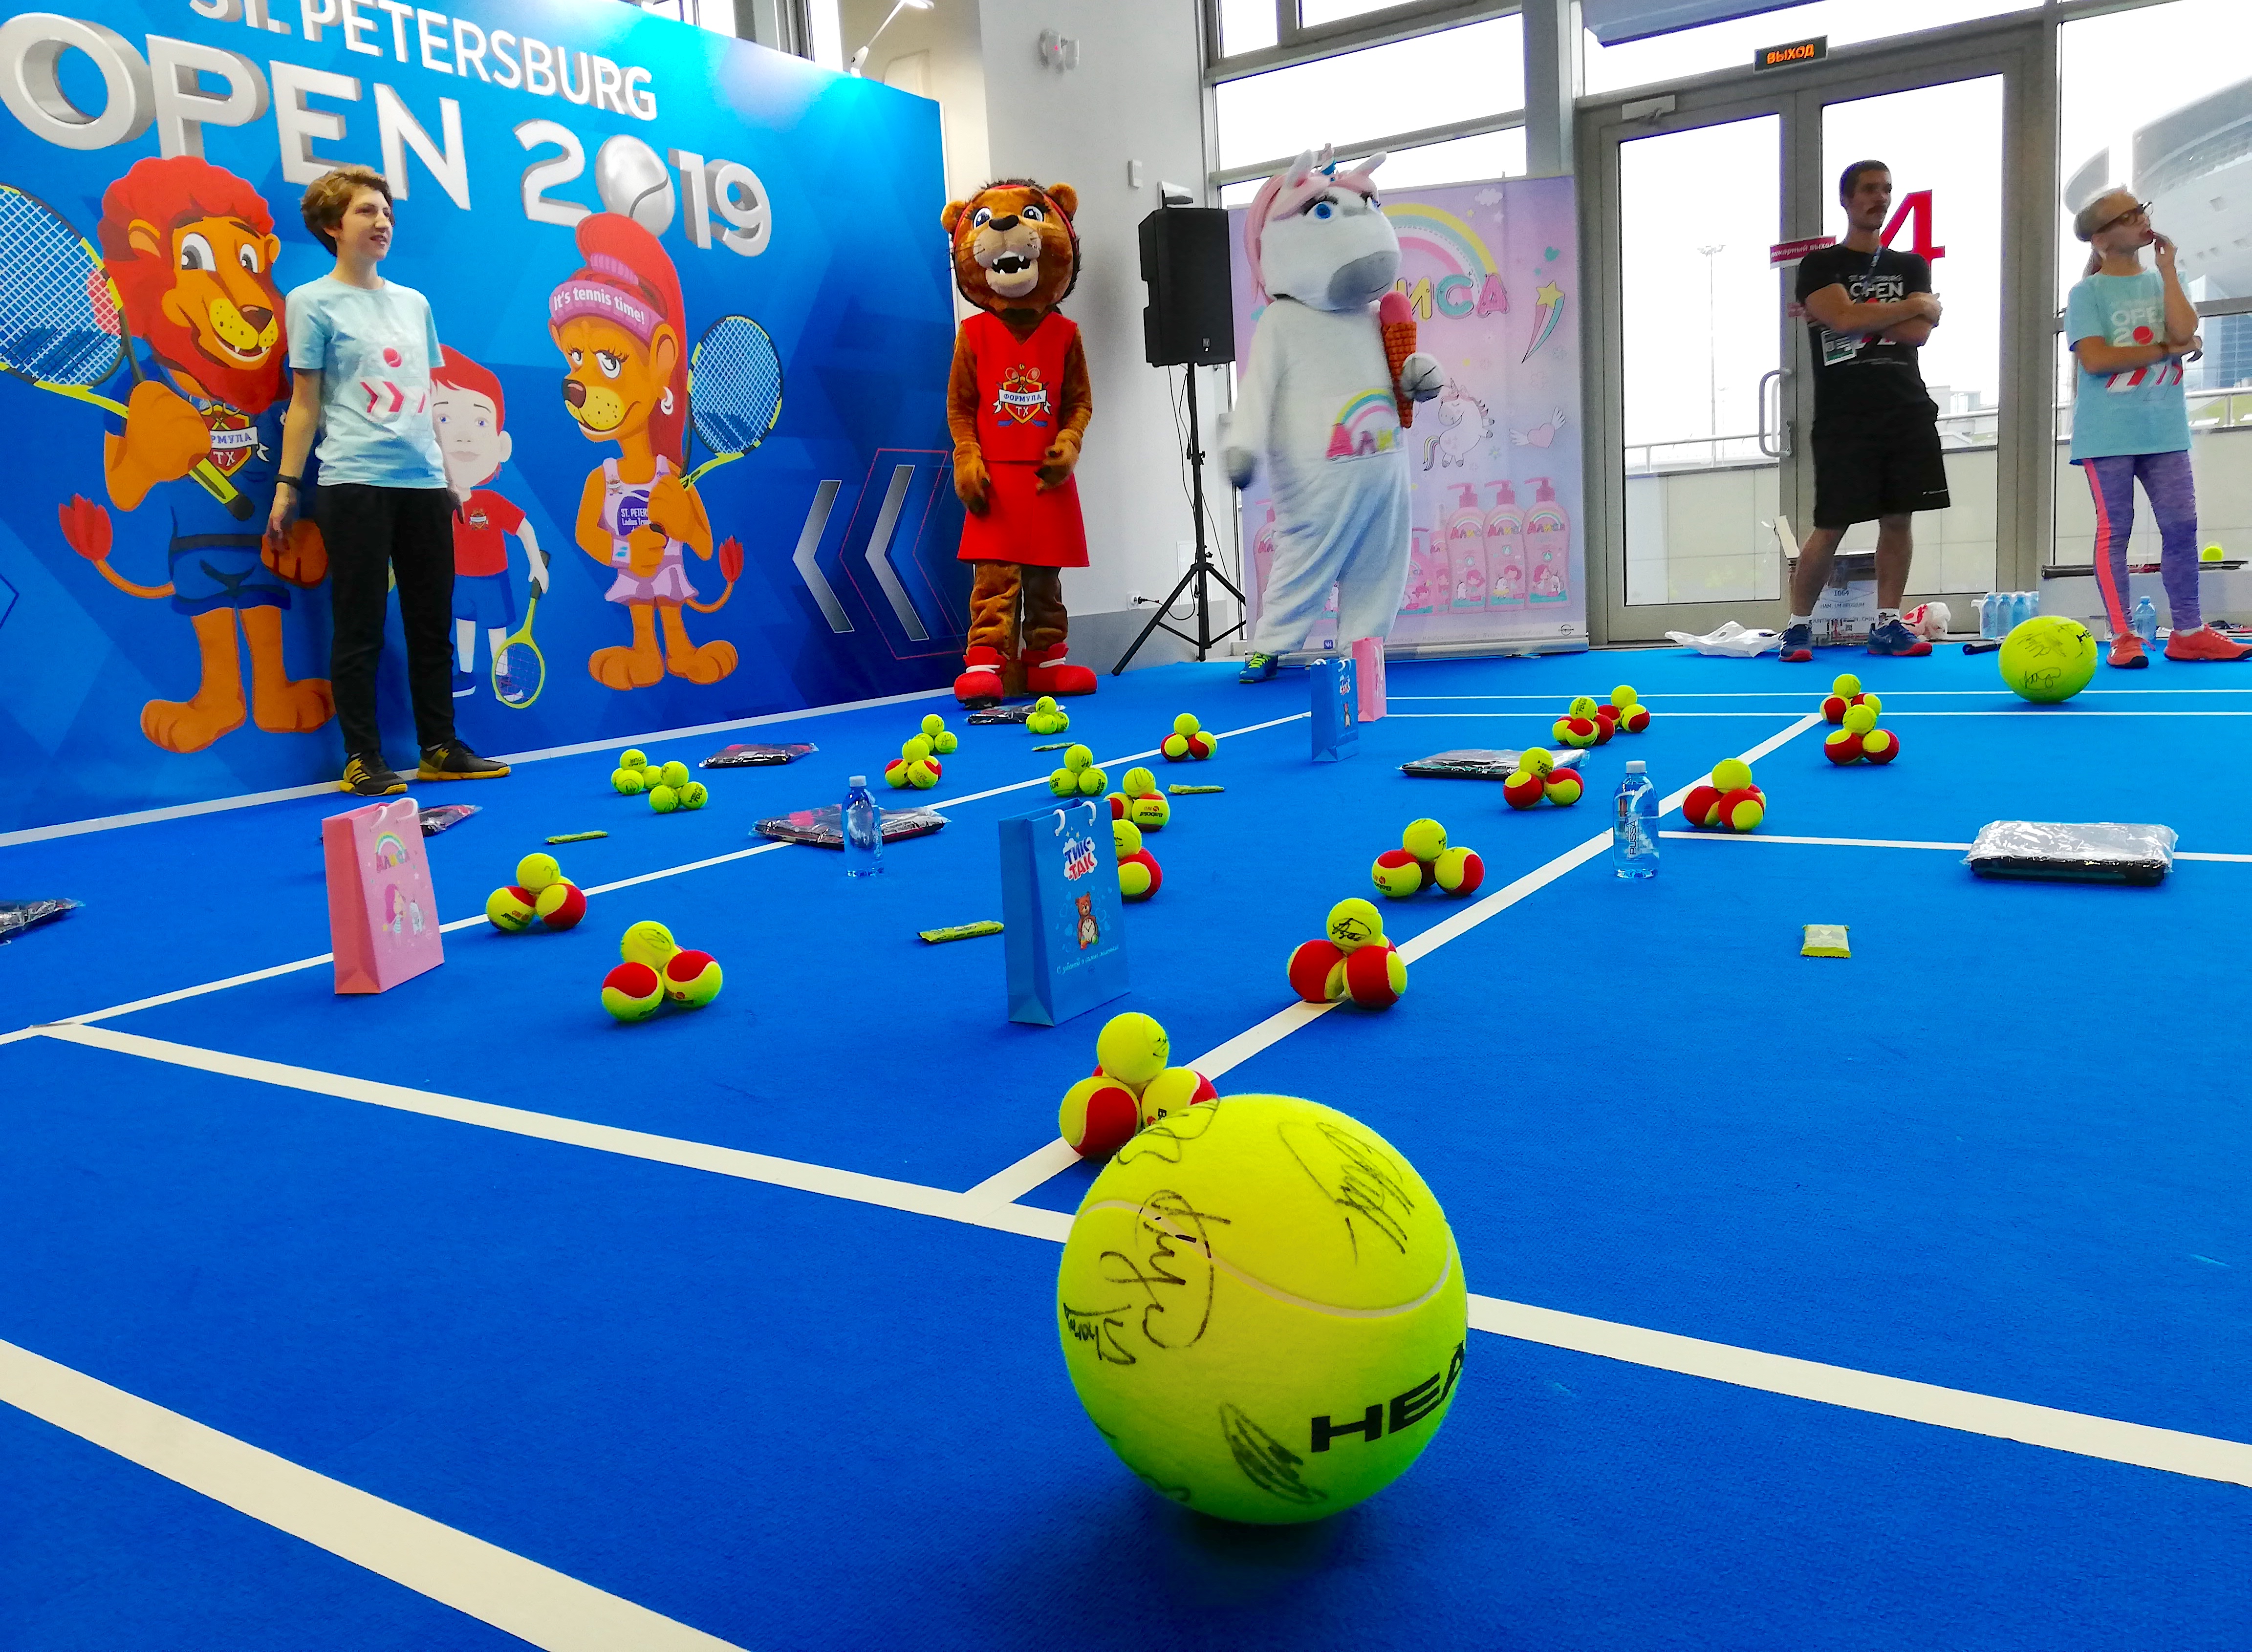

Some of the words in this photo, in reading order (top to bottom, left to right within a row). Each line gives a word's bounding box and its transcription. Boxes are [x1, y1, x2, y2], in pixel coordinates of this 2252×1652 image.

[1767, 43, 1815, 64] ВЫХОД
[0, 13, 471, 210] OPEN
[513, 119, 772, 257] 2019
[1880, 190, 1945, 267] 4
[554, 291, 570, 311] It's
[573, 287, 611, 305] tennis
[614, 296, 645, 325] time!
[1395, 273, 1510, 321] ИСА
[1003, 393, 1042, 402] ФОРМУЛА
[211, 432, 252, 444] РМУЛА
[621, 508, 630, 517] ST.
[630, 508, 648, 517] PETER
[2076, 630, 2091, 643] HE
[1311, 1340, 1465, 1453] HEA
